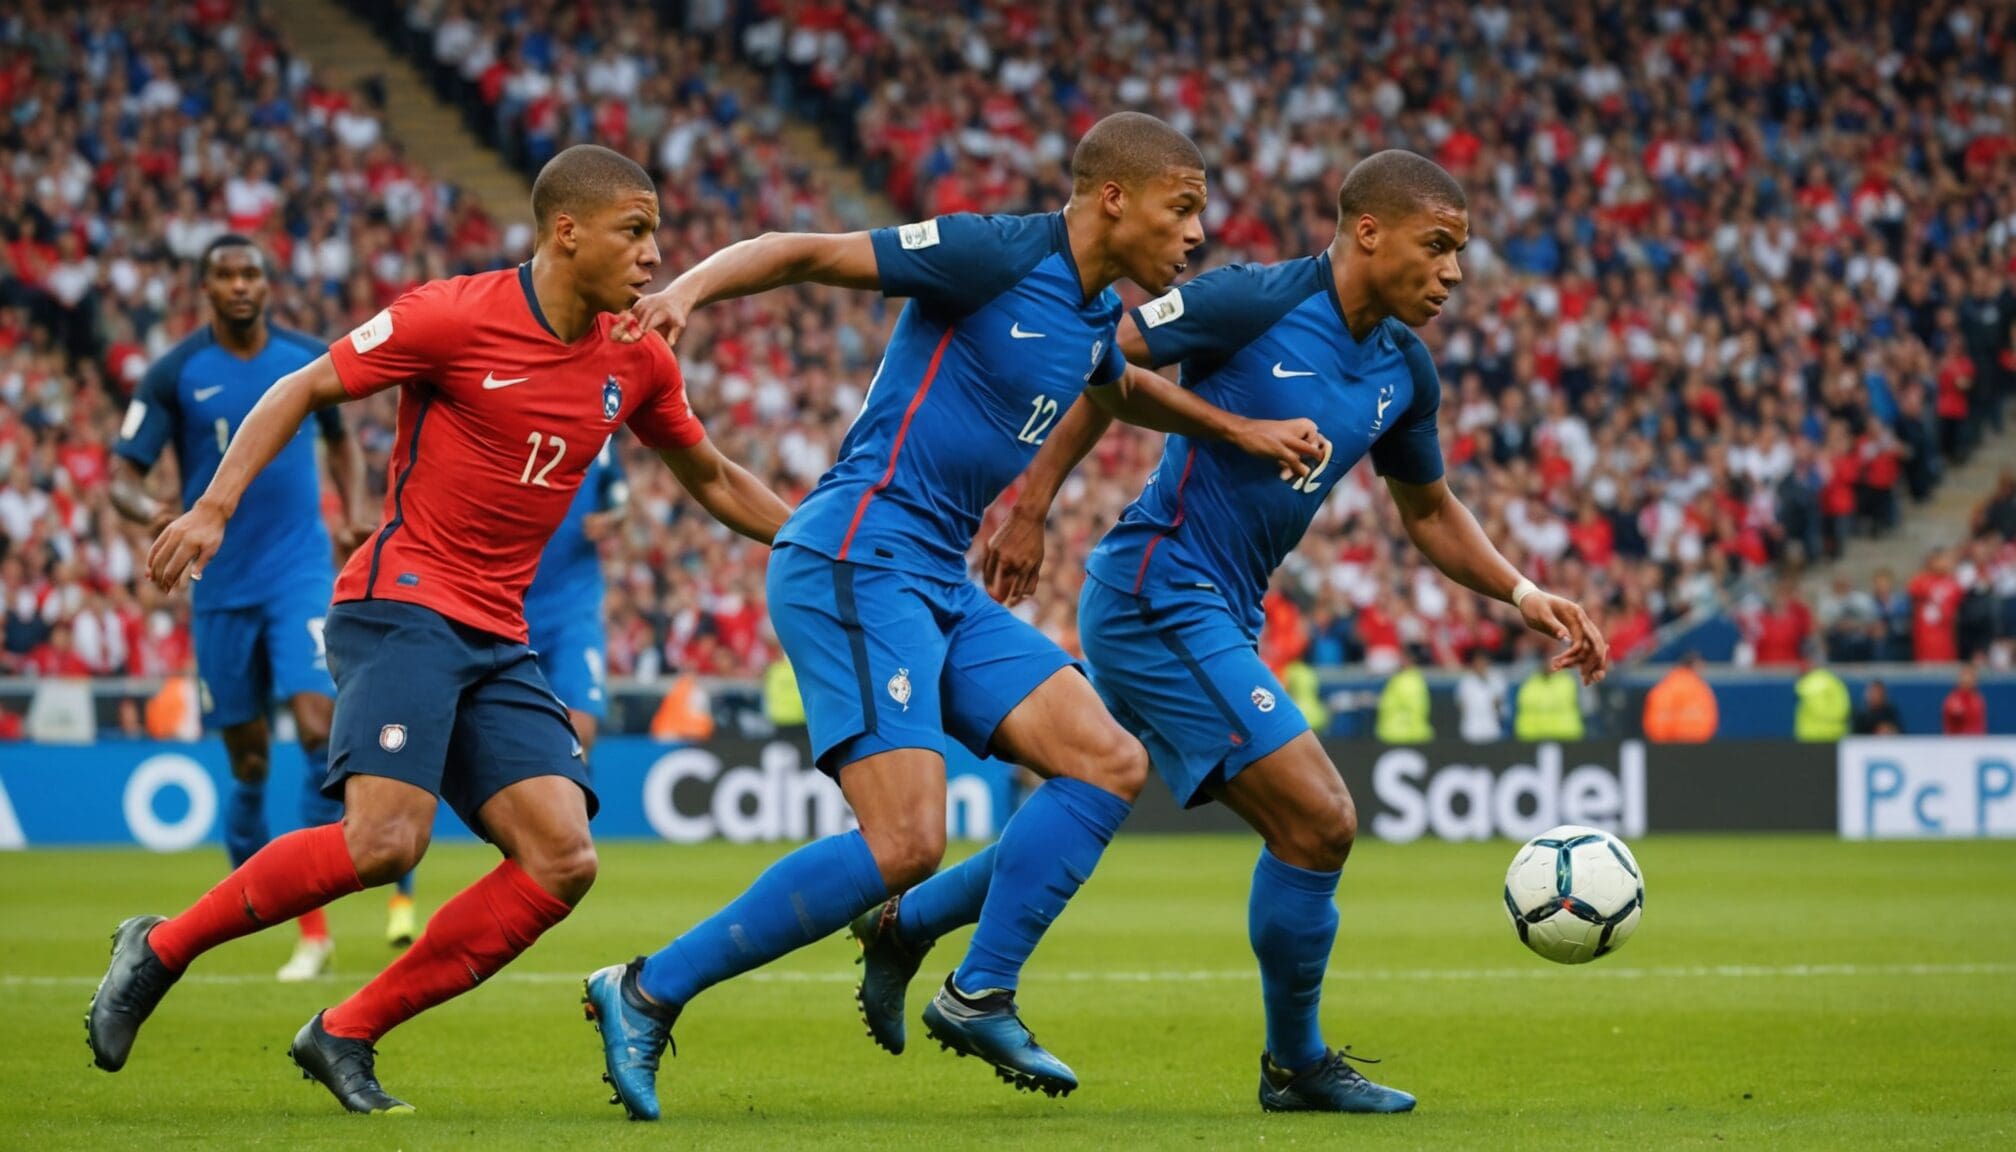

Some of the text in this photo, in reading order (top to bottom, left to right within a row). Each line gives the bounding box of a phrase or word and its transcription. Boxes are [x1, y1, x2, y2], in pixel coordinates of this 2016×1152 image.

[1017, 394, 1058, 446] 12
[520, 431, 567, 488] 12
[1292, 439, 1333, 493] 2
[1372, 740, 1647, 843] Sadel
